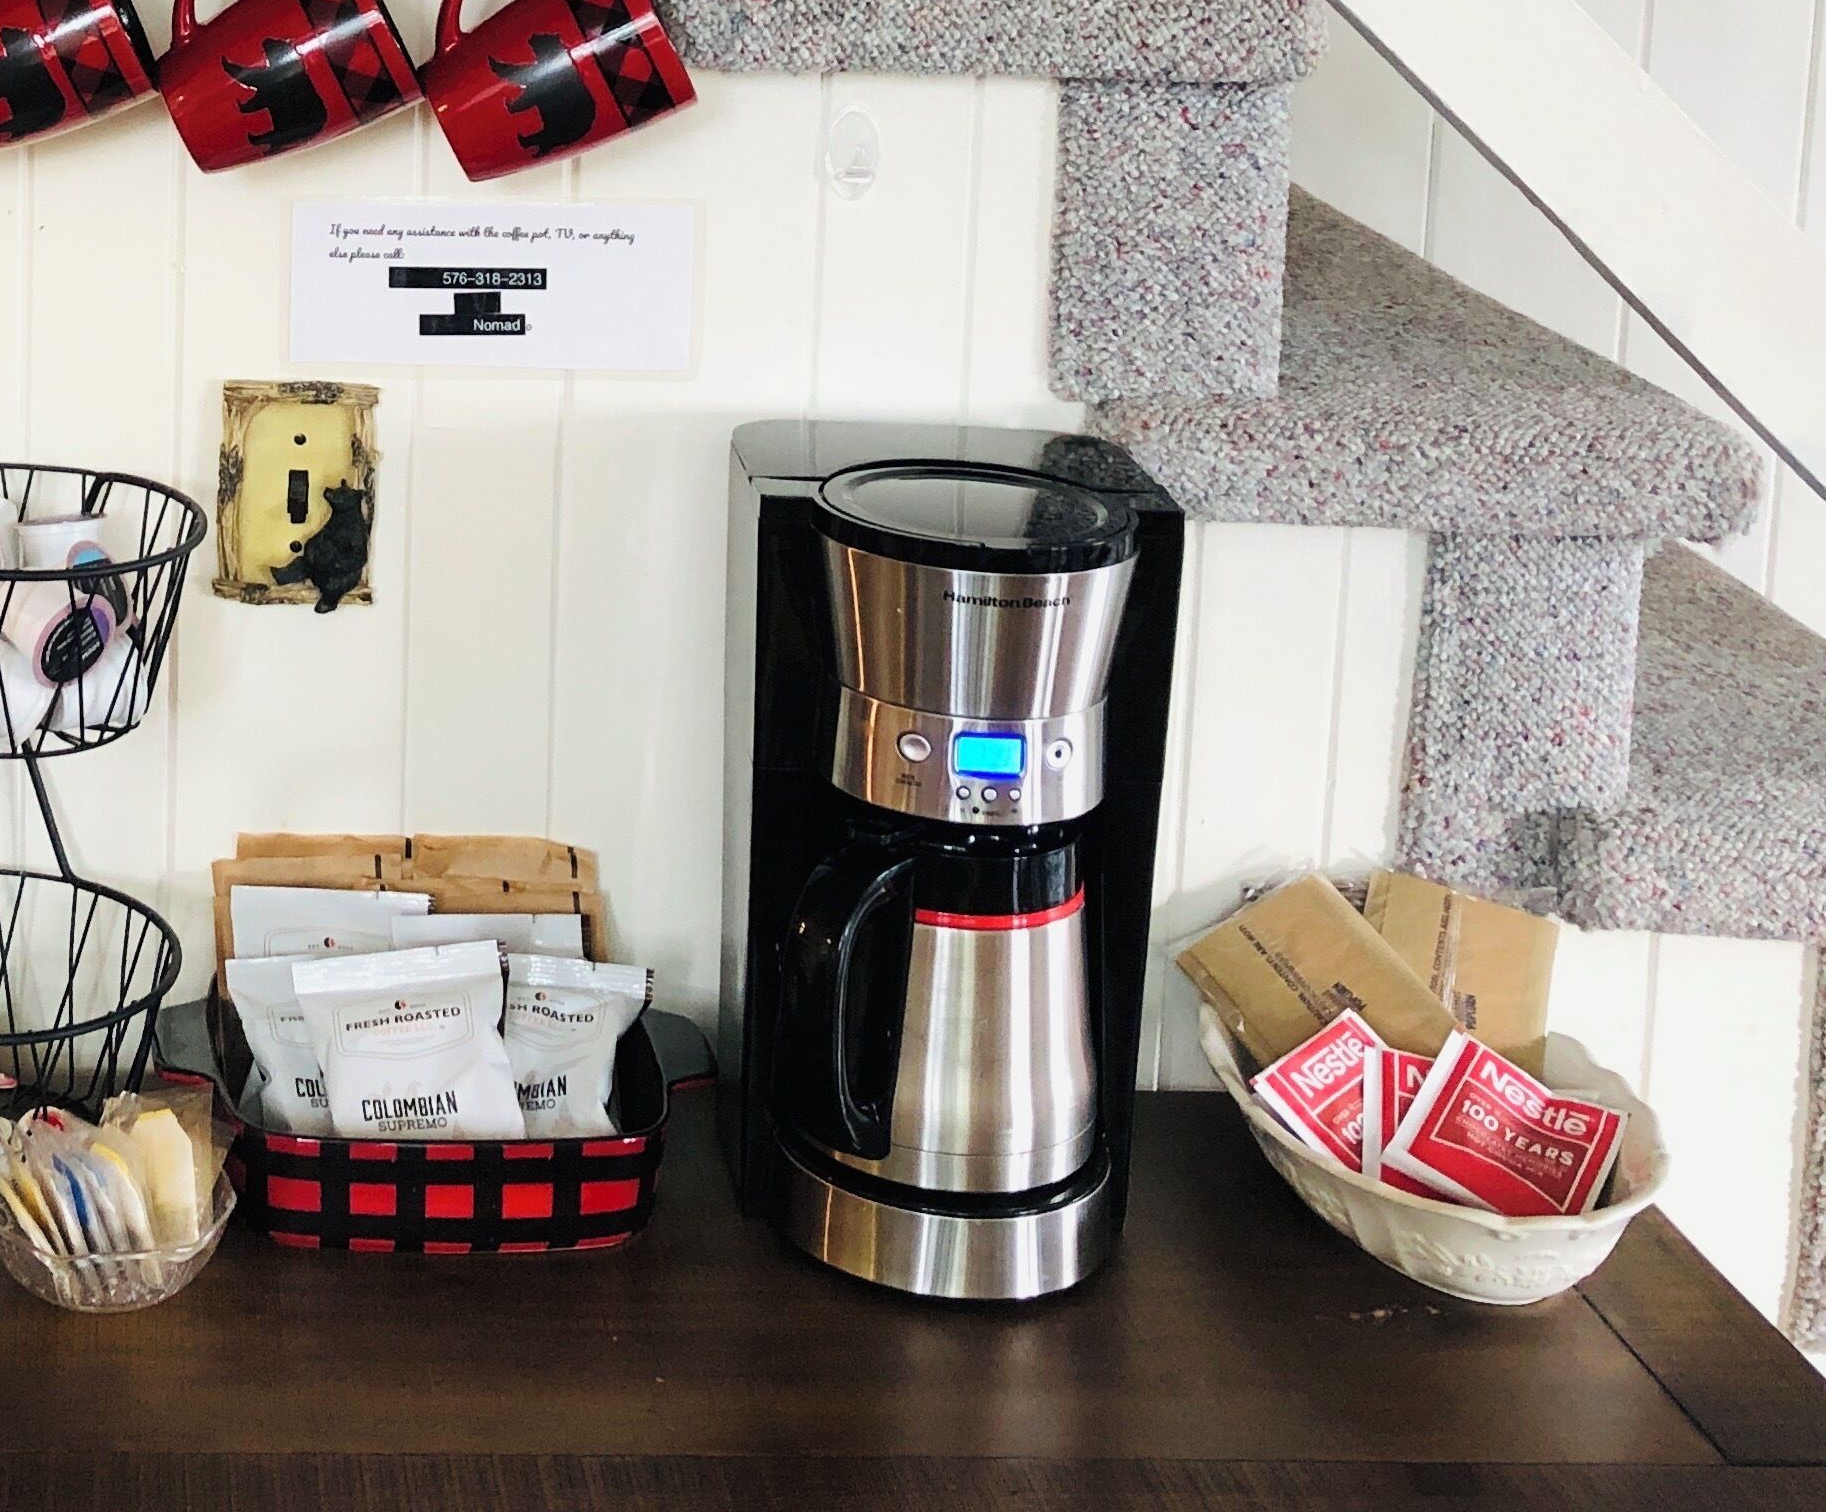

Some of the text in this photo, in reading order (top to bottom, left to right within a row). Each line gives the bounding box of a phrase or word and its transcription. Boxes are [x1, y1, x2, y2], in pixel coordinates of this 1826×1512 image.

[329, 223, 342, 238] If
[343, 228, 360, 240] you
[362, 223, 385, 236] need
[386, 228, 403, 241] any
[406, 225, 456, 237] assistance
[458, 225, 481, 237] with
[483, 225, 499, 238] the
[502, 226, 529, 241] coffee
[530, 227, 552, 243] pot,
[592, 228, 636, 245] anything
[328, 246, 348, 259] else
[349, 246, 381, 263] please
[442, 271, 542, 286] 576-318-2313
[473, 318, 521, 331] Nomad
[345, 1017, 390, 1032] FRESH
[394, 1006, 462, 1024] ROASTED
[532, 1005, 595, 1023] ROASTED
[361, 1090, 459, 1122] COLOMBIAN
[378, 1116, 449, 1133] SUPREMO
[1461, 1099, 1575, 1167] 100 YEARS
